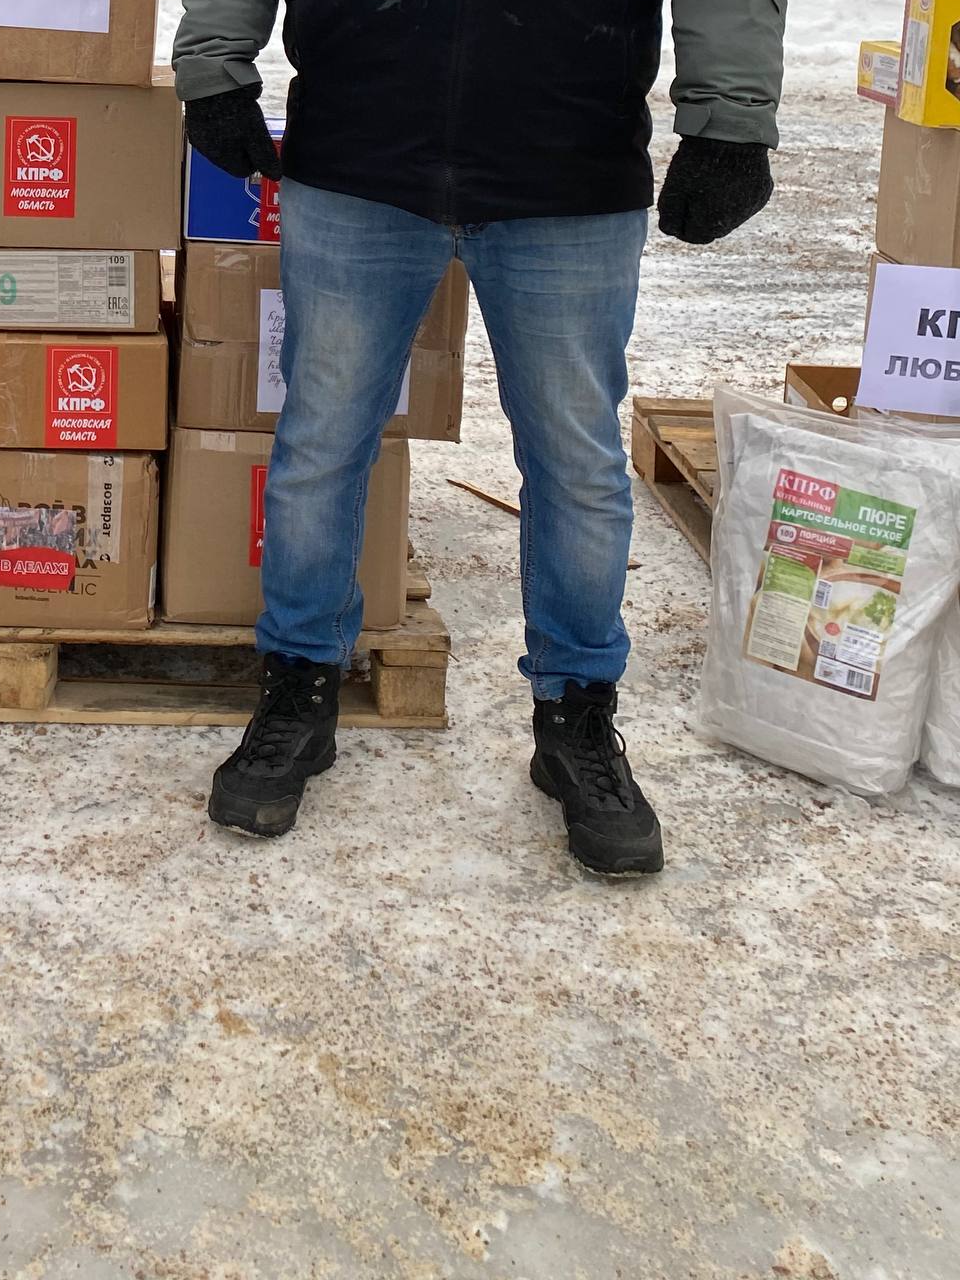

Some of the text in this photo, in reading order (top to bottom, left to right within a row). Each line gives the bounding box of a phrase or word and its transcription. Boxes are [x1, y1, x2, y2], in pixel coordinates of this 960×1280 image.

[17, 167, 64, 181] КПРФ
[11, 187, 70, 198] МОСКОВСКАЯ
[18, 200, 55, 210] ОБЛАСТЬ
[108, 256, 125, 264] 109
[58, 397, 105, 411] КПРФ
[51, 418, 112, 429] МОСКОВСКАЯ
[60, 431, 97, 441] ОБЛАСТЬ
[779, 474, 836, 501] КПРФ
[781, 506, 903, 542] КАРТОФЕЛЬНОЕ СУХОЕ
[858, 506, 908, 530] ПЮРЕ
[800, 530, 837, 545] ПОРЦИЙ
[1, 559, 12, 572] В
[13, 560, 69, 575] ДЕЛАХ!
